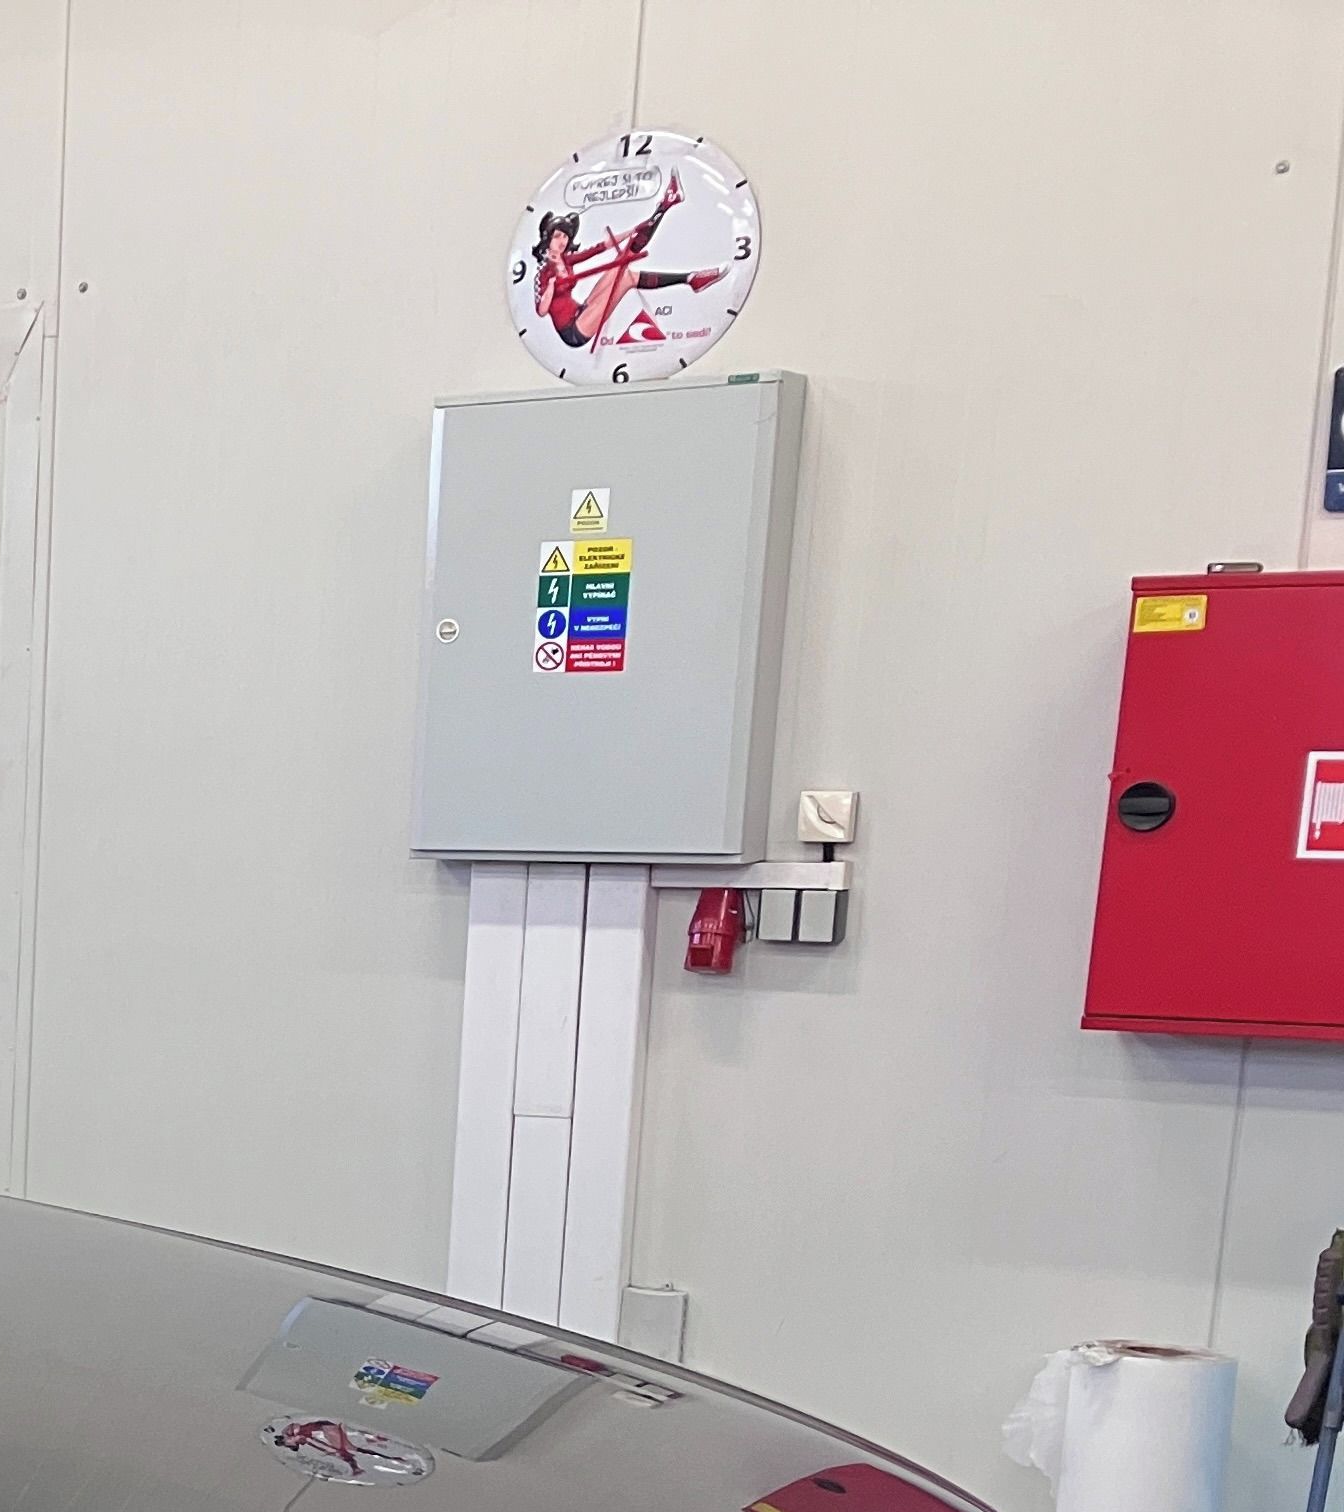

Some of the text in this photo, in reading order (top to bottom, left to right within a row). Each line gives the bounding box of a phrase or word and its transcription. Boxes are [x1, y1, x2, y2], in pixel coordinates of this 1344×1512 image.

[620, 134, 652, 157] 12
[734, 236, 751, 261] 3
[512, 260, 527, 284] 9
[613, 363, 629, 384] 6
